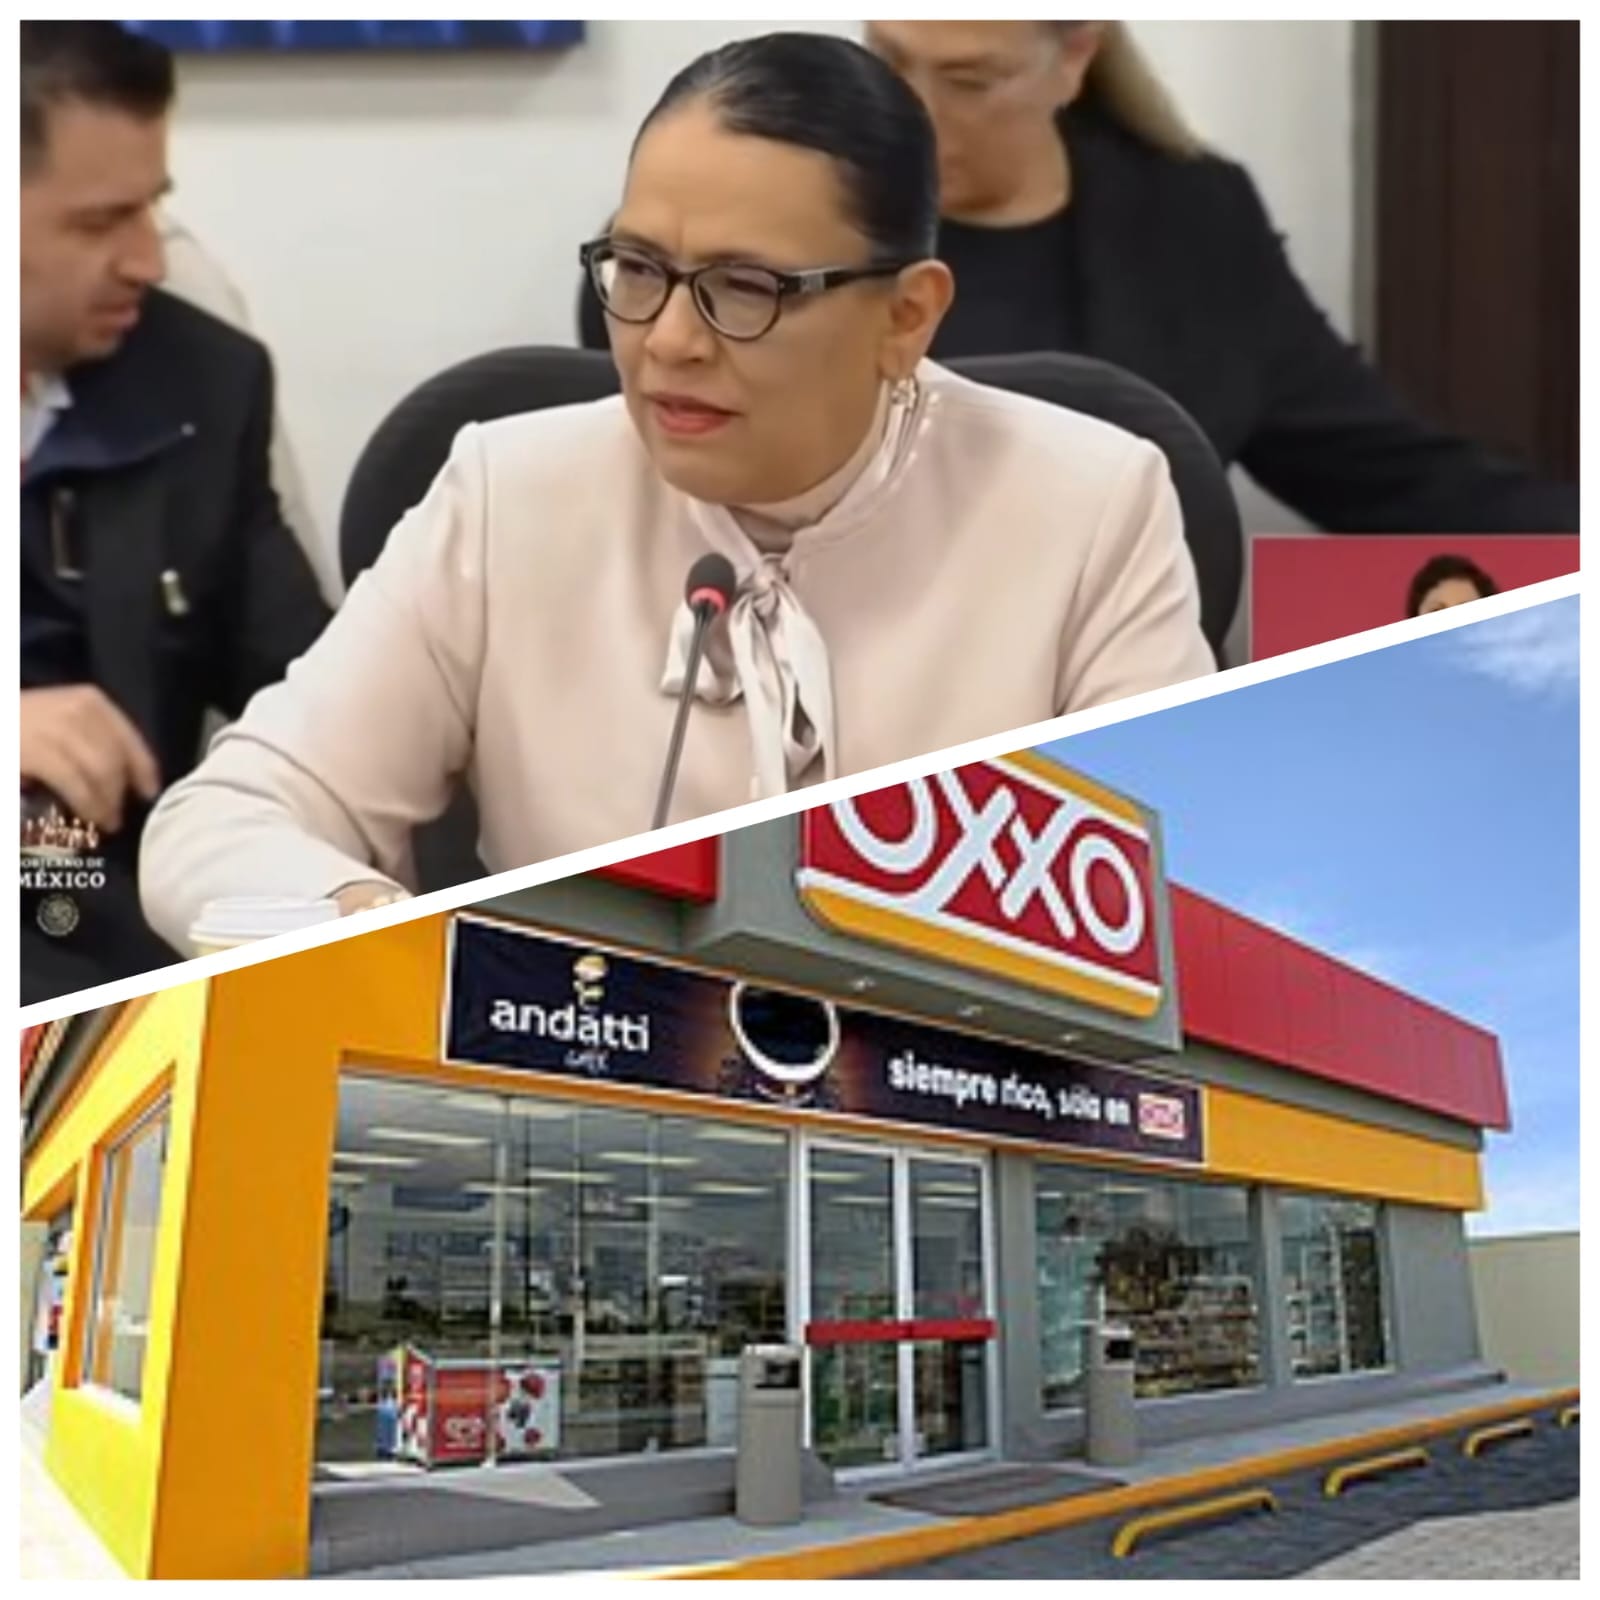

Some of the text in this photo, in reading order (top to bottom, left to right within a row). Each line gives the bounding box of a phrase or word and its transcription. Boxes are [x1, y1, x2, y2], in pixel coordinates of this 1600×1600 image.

[830, 767, 1145, 955] OXXO
[489, 999, 650, 1051] andatti
[888, 1052, 998, 1107] siempre
